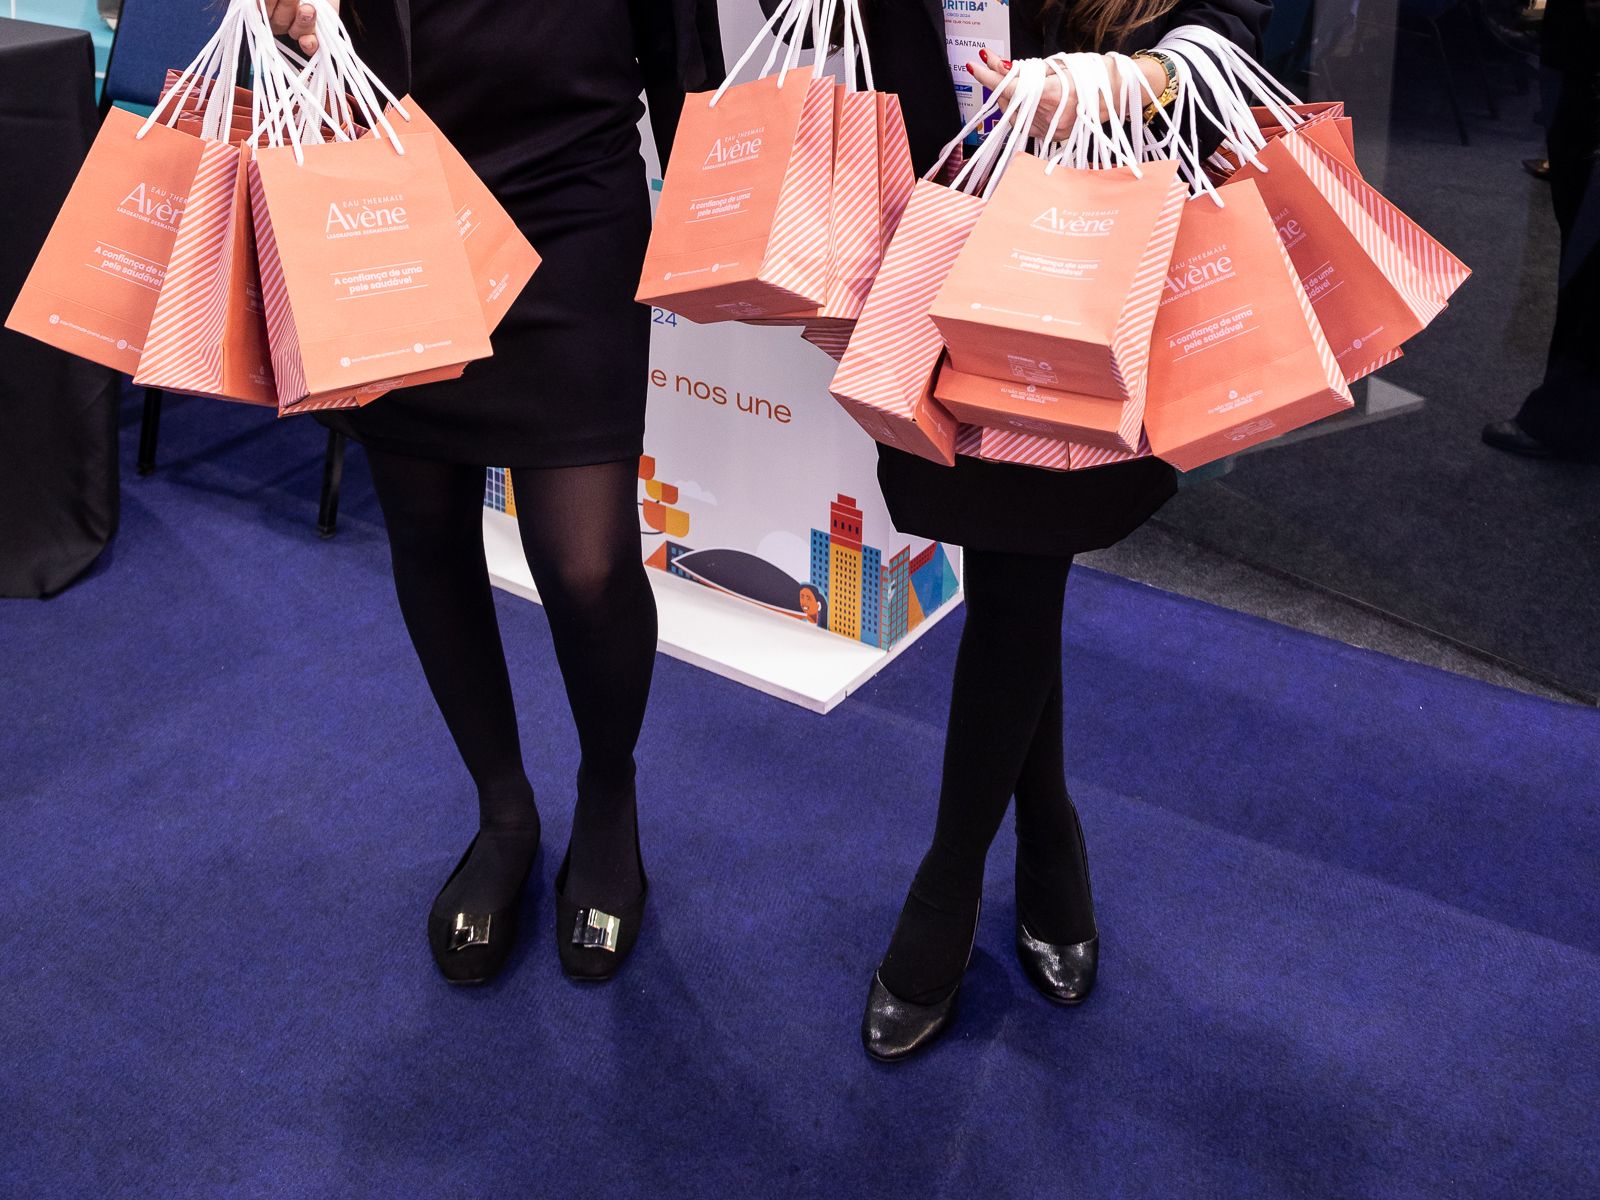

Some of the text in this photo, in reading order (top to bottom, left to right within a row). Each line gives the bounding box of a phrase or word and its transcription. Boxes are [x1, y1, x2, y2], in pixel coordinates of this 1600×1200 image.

[954, 39, 986, 48] SANTANA
[704, 137, 762, 165] Avène
[151, 186, 167, 197] EAU
[343, 194, 403, 208] EAU THERMALE
[326, 202, 407, 233] Avène
[1033, 206, 1116, 232] Avène
[102, 250, 145, 271] confiança
[145, 264, 158, 275] de
[1170, 244, 1228, 273] EAU THERMALE
[101, 260, 162, 287] pele saudável
[342, 270, 388, 284] confiança
[388, 268, 401, 277] de
[401, 266, 423, 275] uma
[349, 275, 412, 295] pele saudável
[652, 308, 678, 328] 24
[1176, 323, 1219, 346] confiança
[1219, 317, 1232, 327] de
[1231, 309, 1253, 322] uma
[1184, 322, 1244, 353] pele saudável
[675, 374, 728, 406] nos
[736, 392, 792, 424] une
